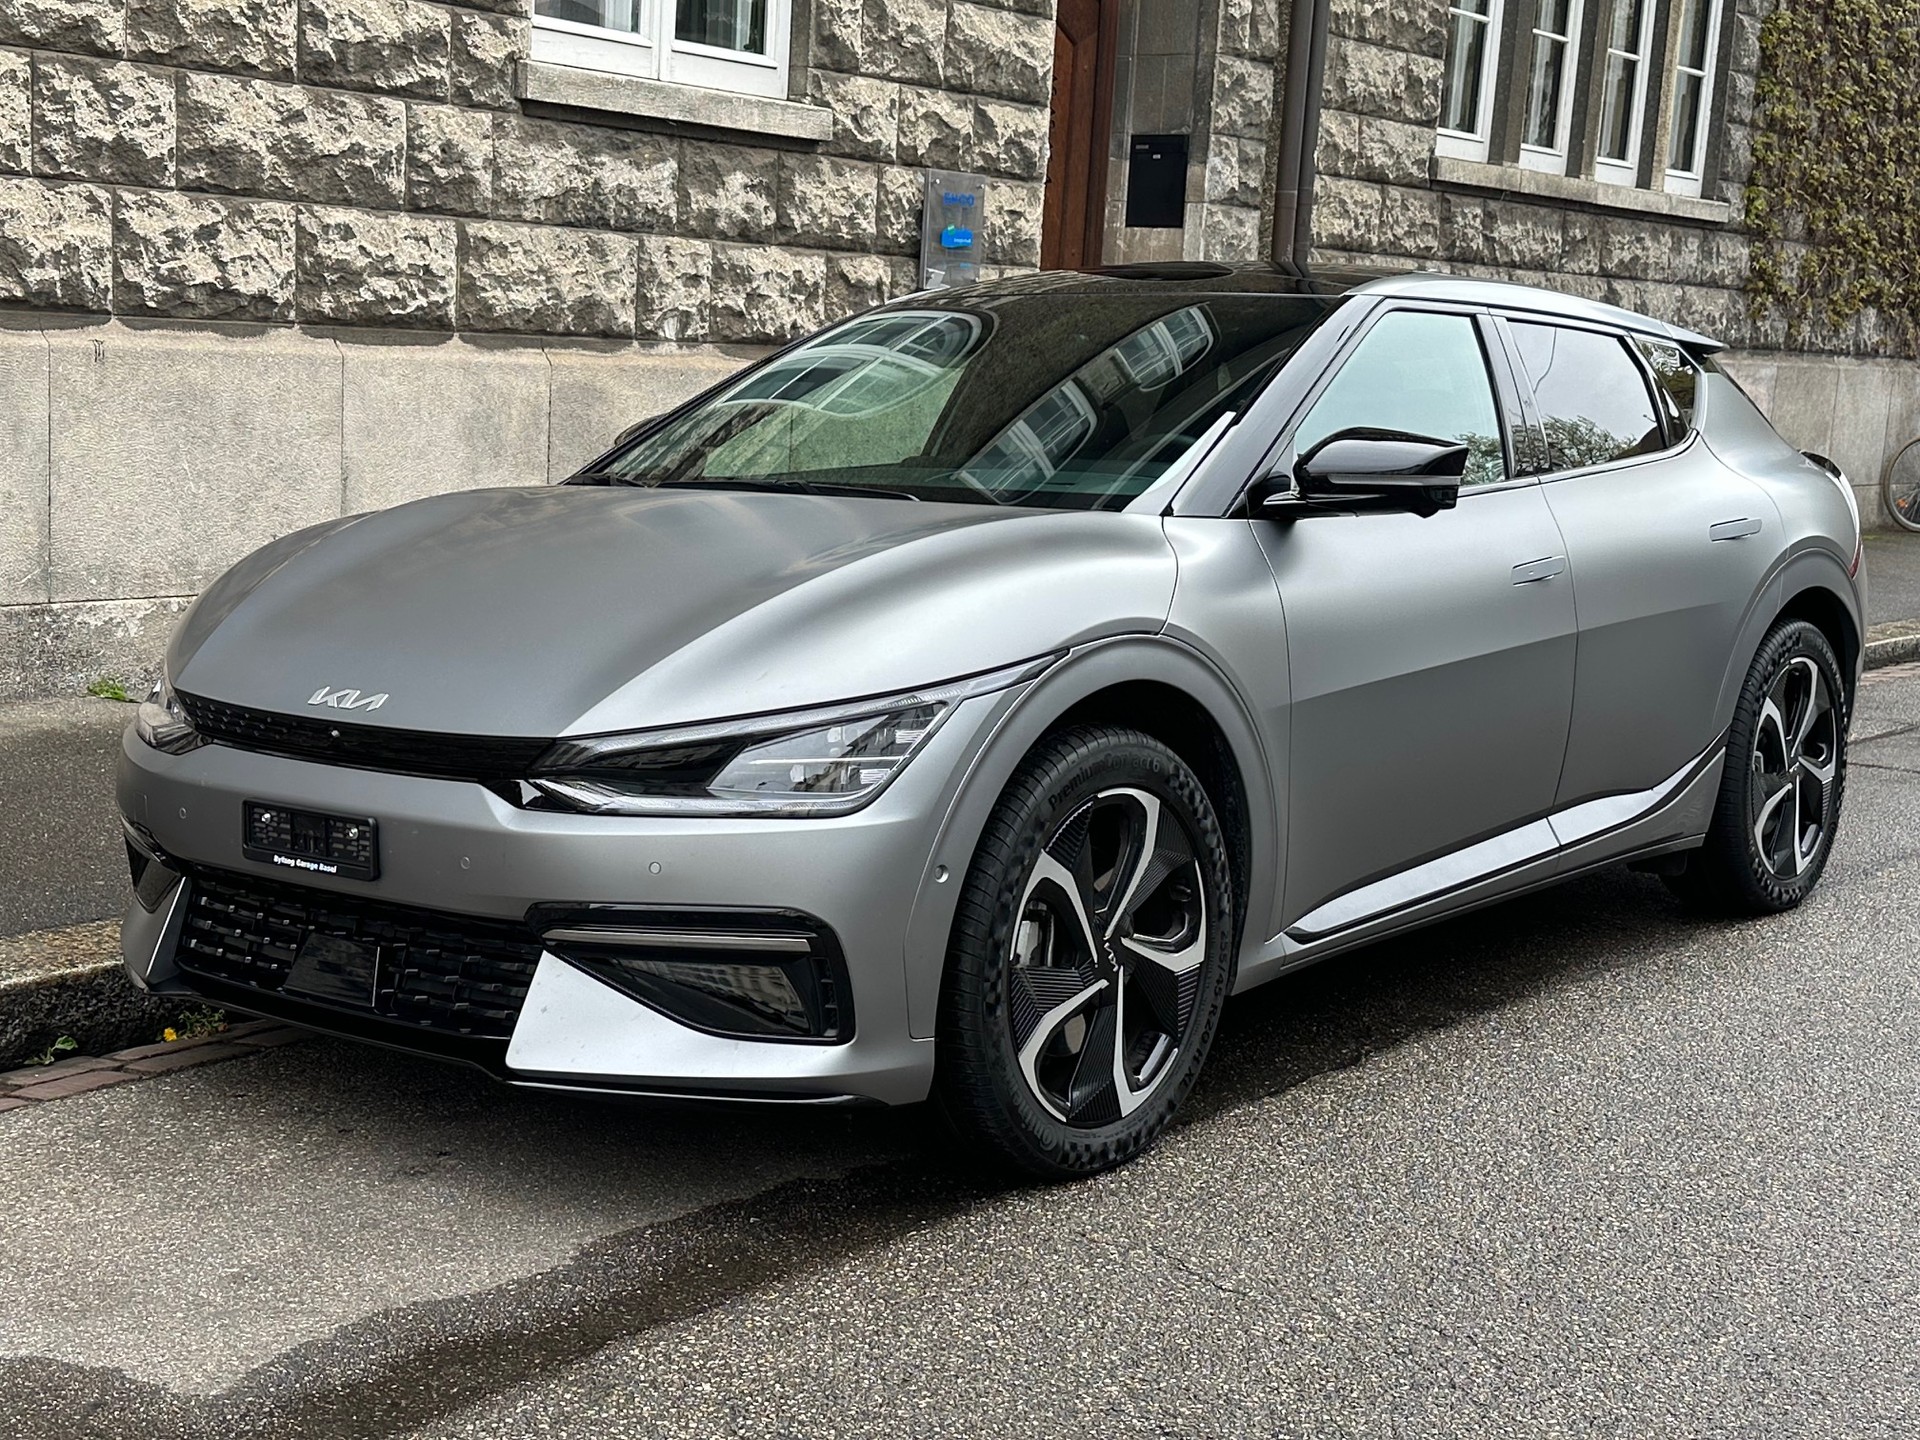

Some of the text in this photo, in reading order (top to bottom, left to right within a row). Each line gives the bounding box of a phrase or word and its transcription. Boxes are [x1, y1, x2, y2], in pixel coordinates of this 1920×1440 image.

[307, 686, 390, 712] KIA
[295, 858, 319, 871] Garage
[318, 862, 338, 874] Basel
[1200, 1002, 1219, 1045] R20
